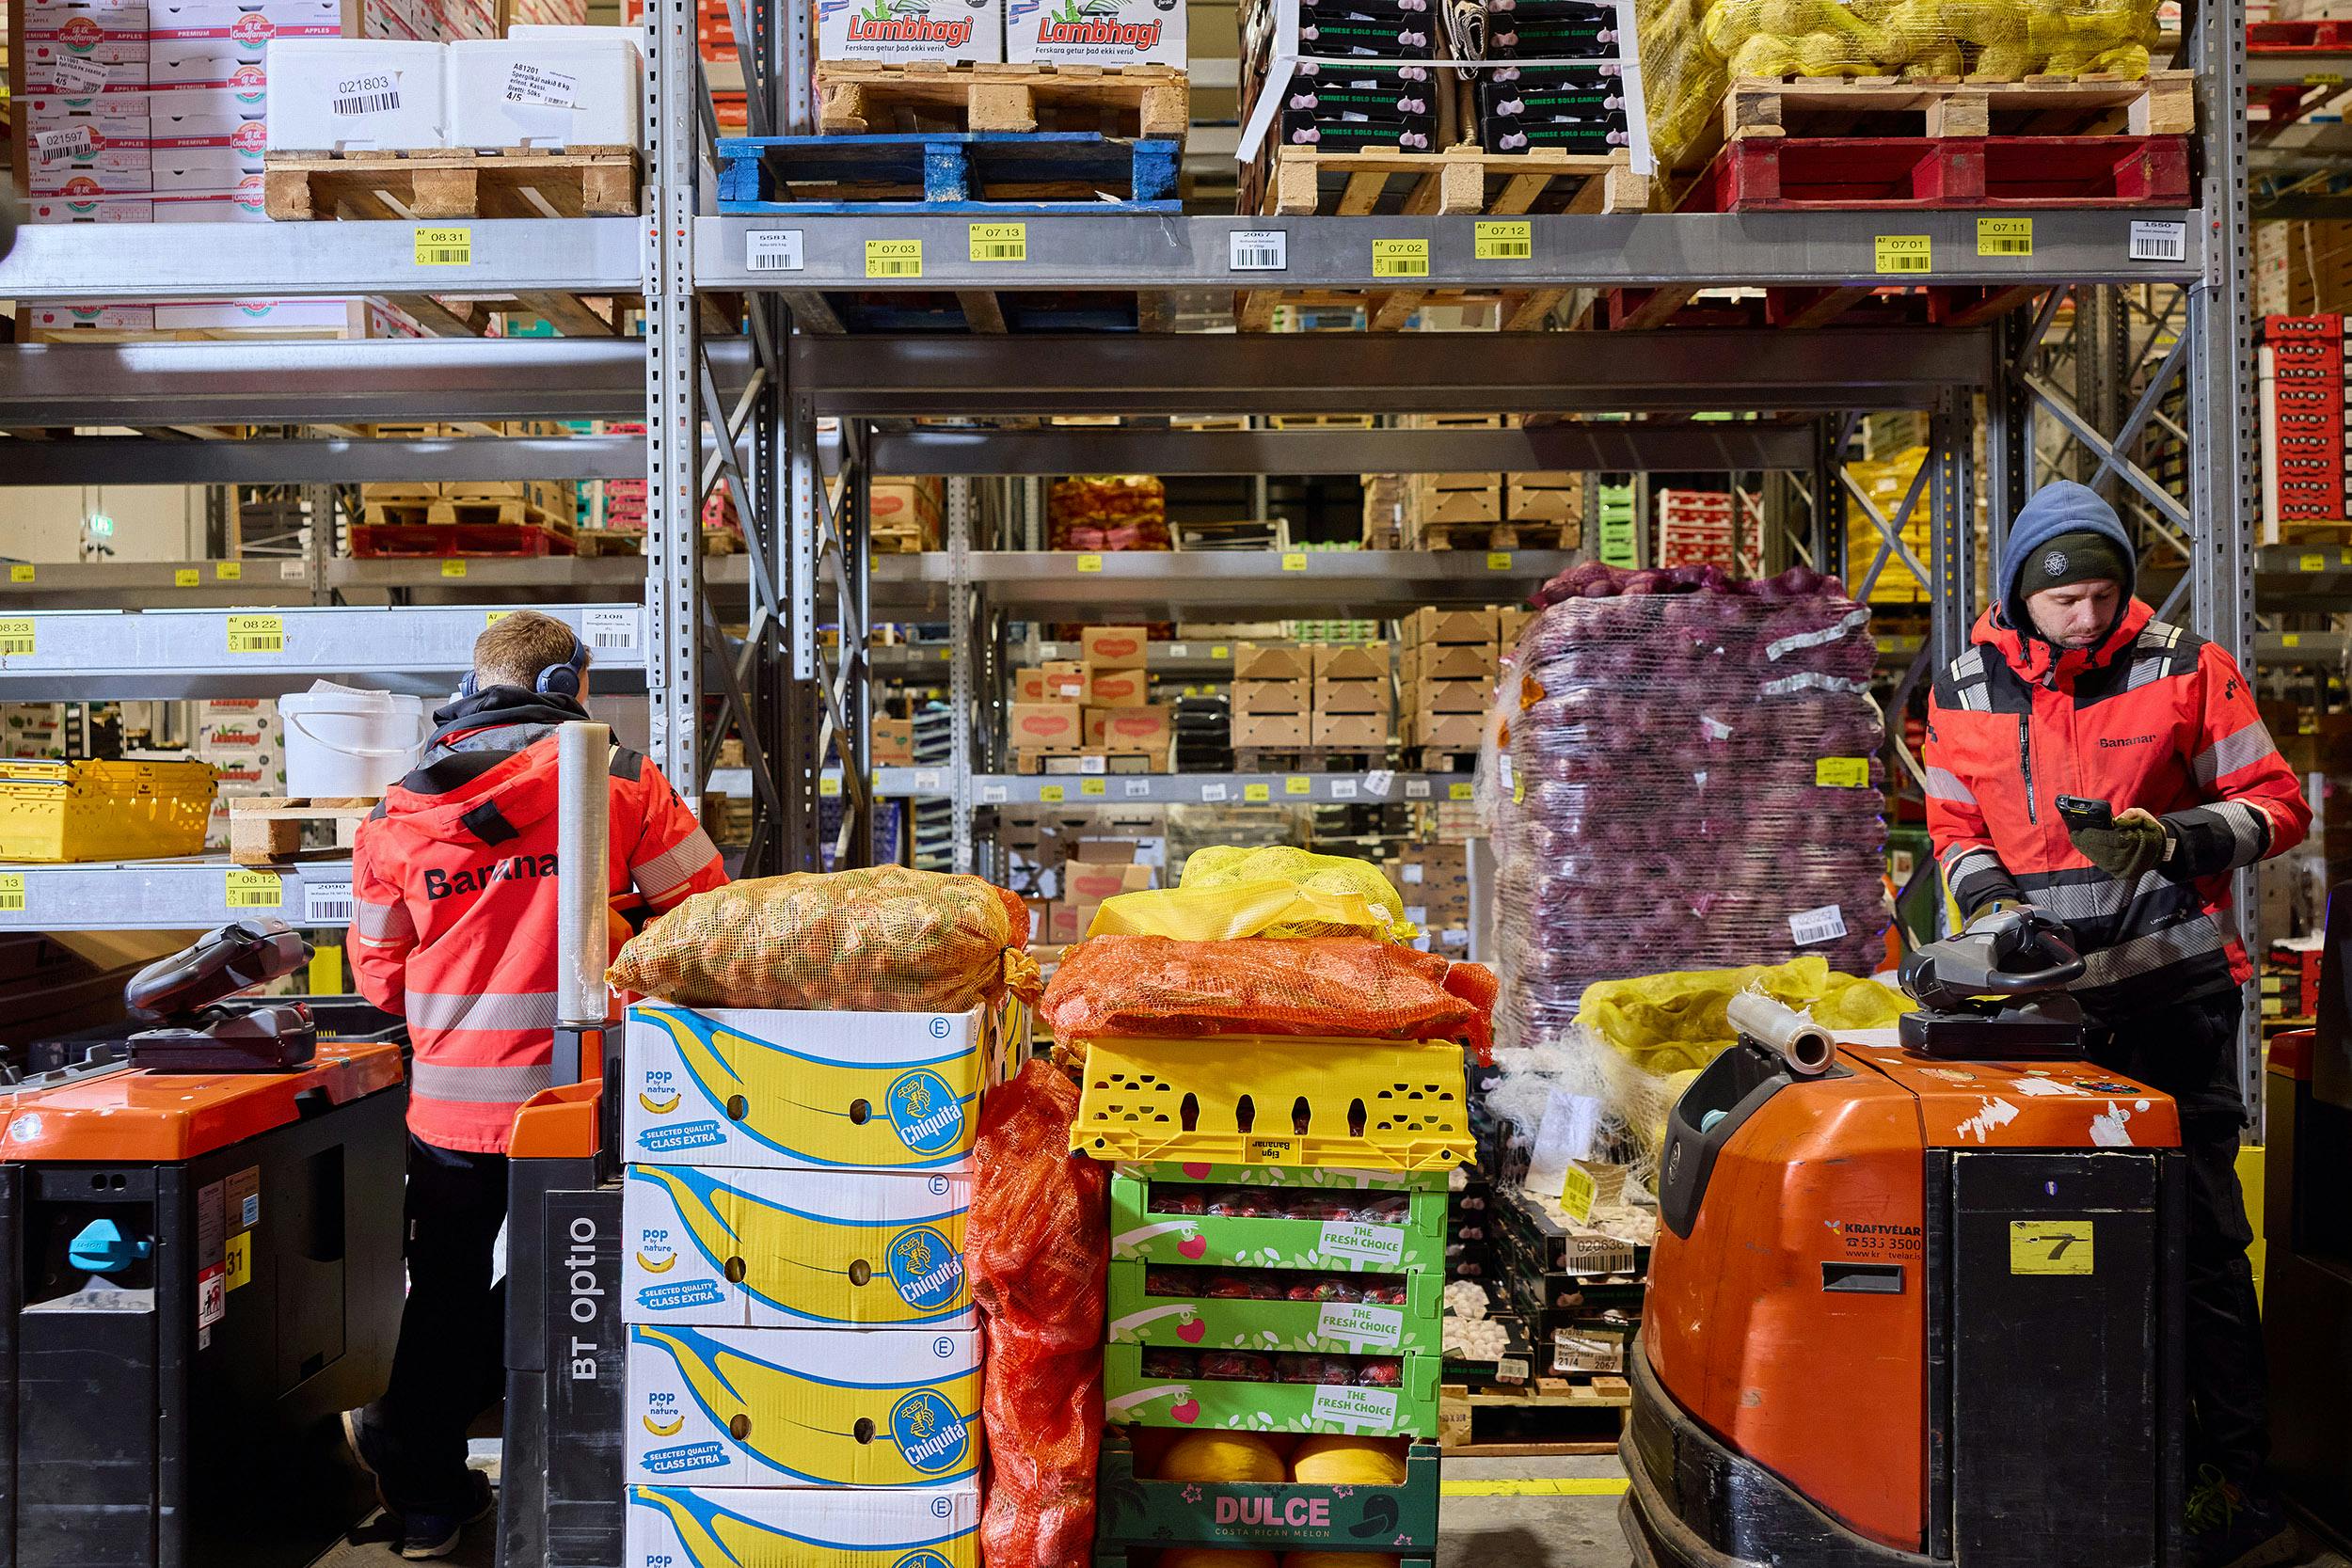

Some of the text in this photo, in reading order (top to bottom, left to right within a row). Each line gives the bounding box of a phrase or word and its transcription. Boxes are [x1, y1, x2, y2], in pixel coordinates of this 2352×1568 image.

[232, 30, 275, 40] Goodfarmer
[847, 14, 974, 48] Lambhagi
[1038, 17, 1163, 51] Lambhagi
[60, 34, 103, 43] Goodfarmer
[897, 44, 910, 54] það
[1086, 47, 1099, 56] það
[56, 77, 67, 86] 4/5
[339, 76, 389, 94] 021803
[508, 85, 526, 94] Bretti:
[506, 91, 522, 102] 4/5
[47, 132, 83, 146] 021597
[232, 138, 265, 150] Goodfarm
[985, 229, 1002, 237] 07
[1005, 229, 1020, 237] 13
[1491, 227, 1507, 235] 07
[1510, 227, 1525, 235] 12
[882, 245, 898, 253] 07
[900, 245, 915, 253] 03
[1389, 244, 1405, 253] 07
[1406, 244, 1422, 253] 02
[2099, 735, 2156, 748] Bananar
[5, 879, 19, 887] 13
[646, 1070, 673, 1084] pop
[899, 1103, 962, 1146] Chiquita
[646, 1124, 715, 1139] SELECTED QUALITY
[651, 1132, 716, 1148] CLASS EXTRA
[1252, 1141, 1290, 1149] Bananar
[1262, 1148, 1279, 1159] Eign
[643, 1228, 668, 1242] pop
[1354, 1226, 1373, 1237] THE
[1845, 1224, 1921, 1236] KRAFTVÉLAR
[1324, 1233, 1399, 1252] FRESH CHOICE
[1577, 1239, 1625, 1252] 020636
[1889, 1238, 1921, 1250] 3500
[2039, 1236, 2075, 1259] 7
[227, 1248, 243, 1276] 31
[899, 1259, 962, 1302] Chiquita
[645, 1282, 713, 1297] SELECTED QUALITY
[564, 1217, 605, 1379] BT optio
[649, 1291, 714, 1307] CLASS EXTRA
[1352, 1308, 1372, 1319] THE
[1323, 1316, 1397, 1334] FRESH CHOICE
[1558, 1356, 1579, 1367] 21/4
[649, 1392, 675, 1404] pop
[1346, 1390, 1367, 1401] THE
[1318, 1397, 1392, 1417] FRESH CHOICE
[904, 1423, 967, 1465] Chiquita
[650, 1445, 719, 1461] SELECTED QUALITY
[654, 1454, 720, 1470] CLASS EXTRA
[1216, 1497, 1330, 1527] DULCE
[647, 1555, 673, 1568] pop
